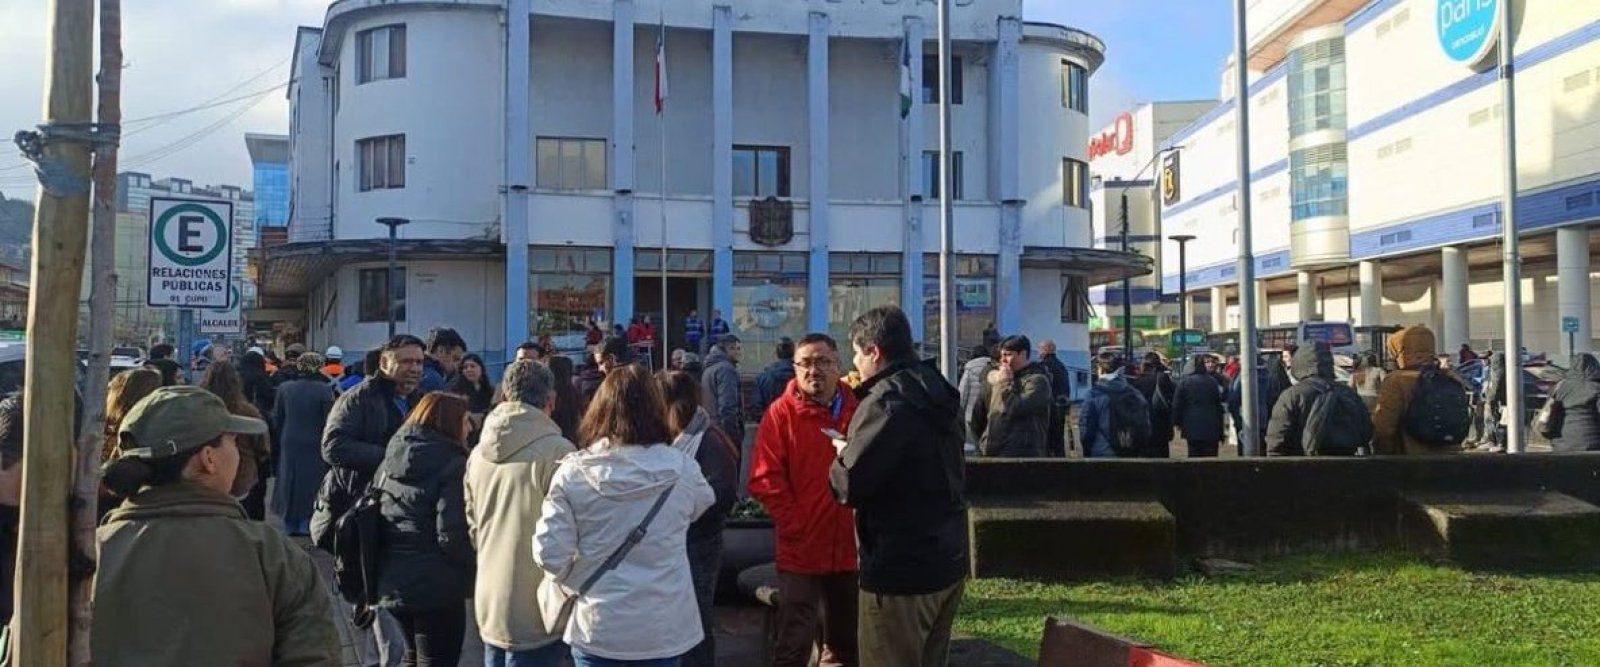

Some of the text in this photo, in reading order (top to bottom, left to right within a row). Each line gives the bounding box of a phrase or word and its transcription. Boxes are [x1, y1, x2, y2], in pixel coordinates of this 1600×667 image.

[178, 216, 204, 252] E
[152, 267, 226, 279] RELACIONES
[185, 295, 208, 303] CUPO
